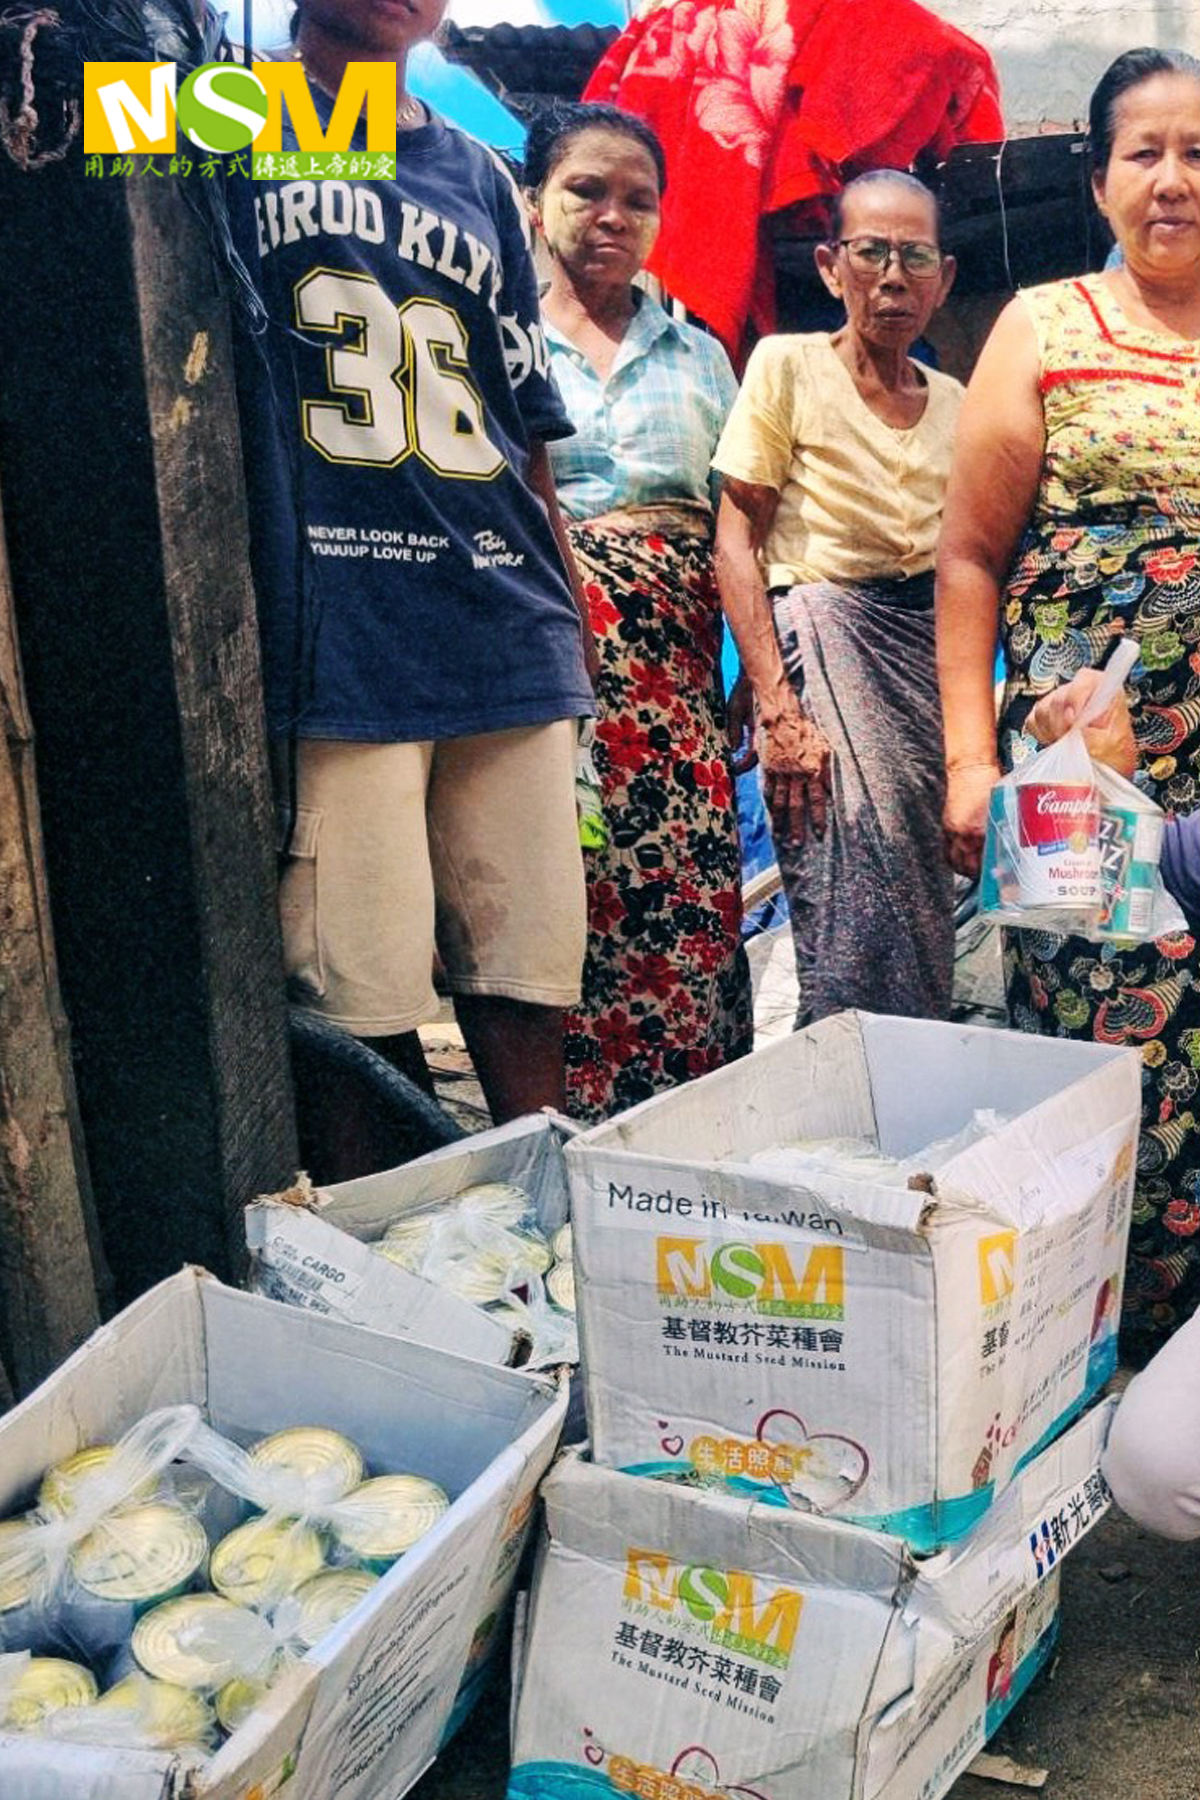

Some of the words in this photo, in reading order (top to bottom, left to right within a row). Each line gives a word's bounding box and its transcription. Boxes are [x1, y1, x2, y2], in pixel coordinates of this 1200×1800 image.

[294, 267, 508, 481] 36
[307, 525, 357, 541] NEVER
[360, 528, 404, 544] LOOK
[408, 533, 449, 548] BACK
[373, 546, 412, 561] LOVE
[416, 550, 437, 563] UP
[608, 1182, 693, 1216] Made
[701, 1194, 727, 1221] in
[302, 1256, 346, 1283] CARGO
[661, 1316, 844, 1353] 基督教芥菜種會
[662, 1345, 688, 1358] The
[694, 1348, 749, 1364] Mustard
[755, 1352, 786, 1366] Seed
[791, 1356, 846, 1371] Mission
[614, 1620, 783, 1704] 基督教芥菜種會
[611, 1651, 632, 1668] The
[637, 1660, 689, 1689] Mustard
[693, 1681, 721, 1703] Seed
[726, 1693, 776, 1725] Mission
